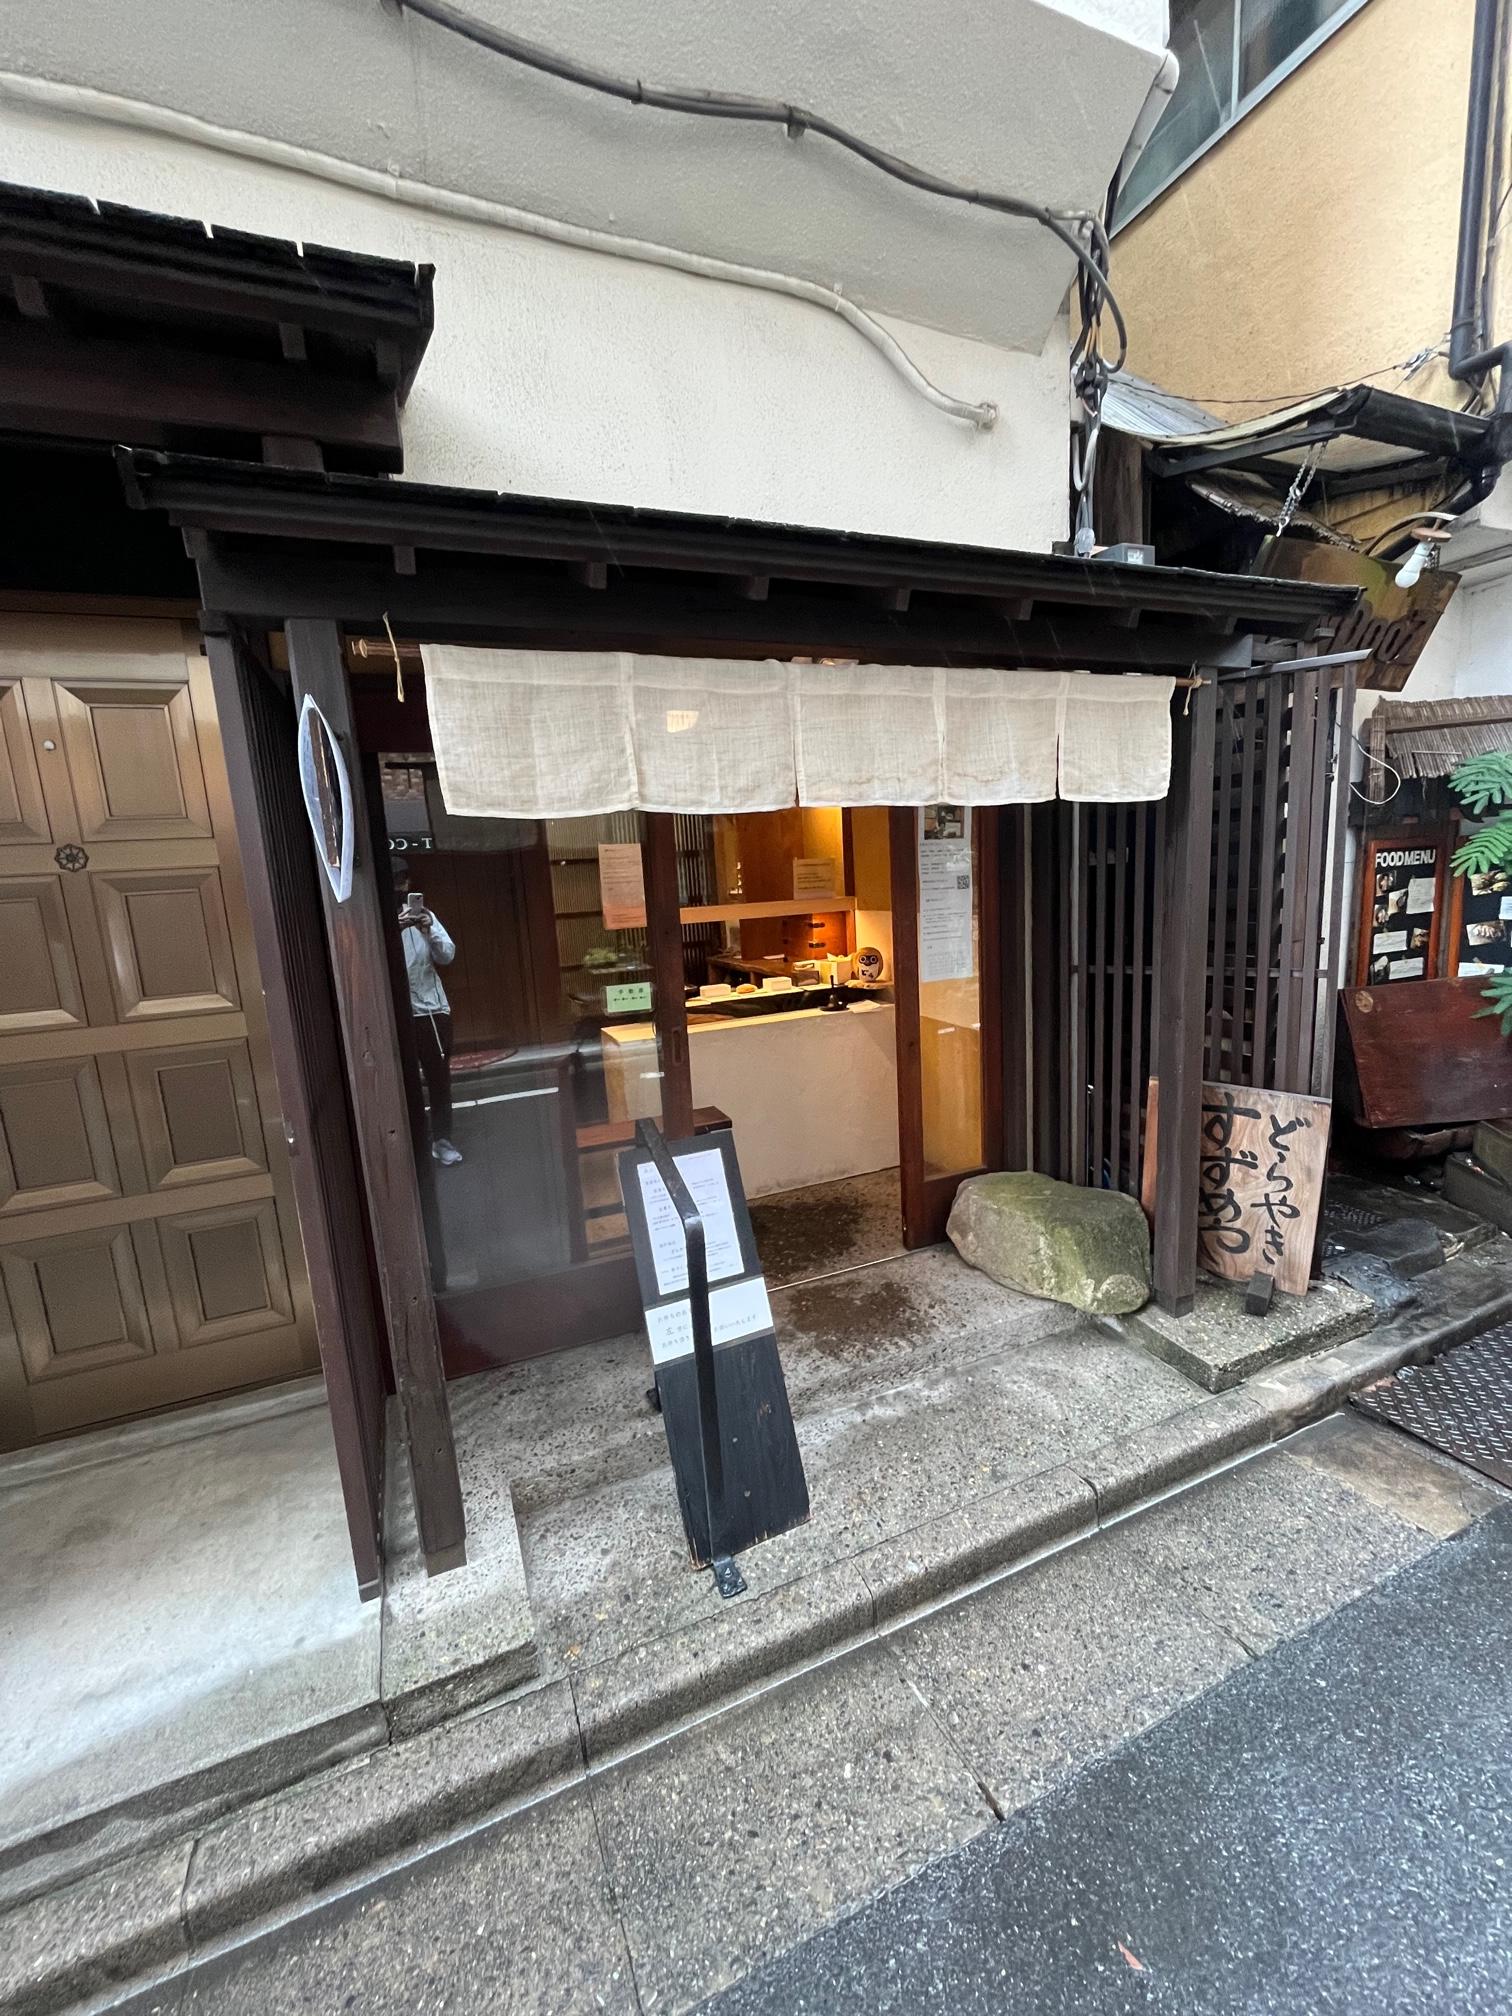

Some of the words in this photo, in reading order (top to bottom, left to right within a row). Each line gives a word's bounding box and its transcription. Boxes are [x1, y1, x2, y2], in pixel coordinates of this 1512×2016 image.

[1375, 851, 1405, 868] FOOD
[1404, 849, 1436, 865] MENU
[1199, 1092, 1261, 1265] すずめや
[1251, 1113, 1312, 1265] どらやき
